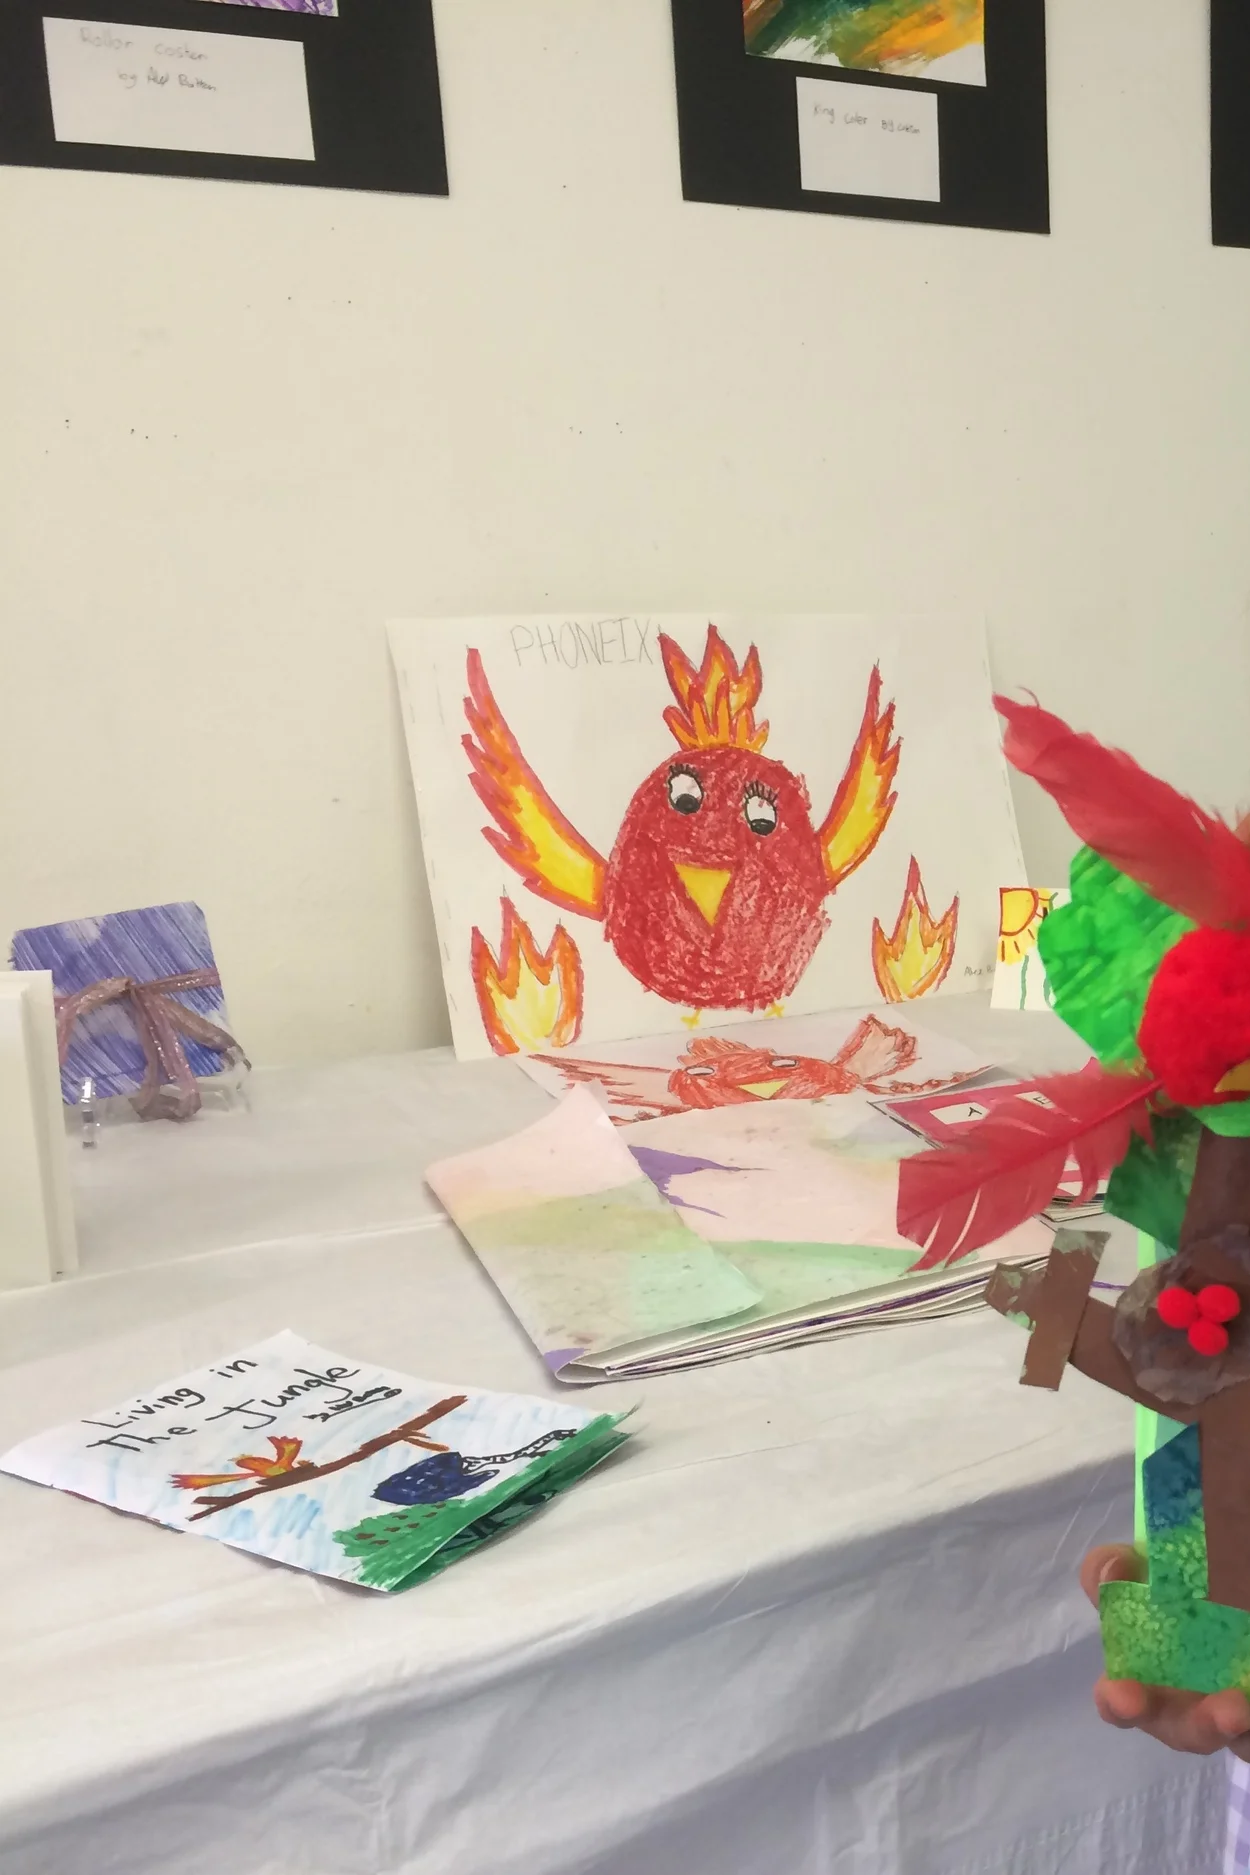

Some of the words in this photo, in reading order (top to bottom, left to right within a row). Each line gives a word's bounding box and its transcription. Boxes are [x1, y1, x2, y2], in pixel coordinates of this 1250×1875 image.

[509, 616, 654, 670] PHONEIX
[80, 1387, 206, 1430] Living
[209, 1359, 259, 1379] in
[205, 1365, 361, 1430] Jungle
